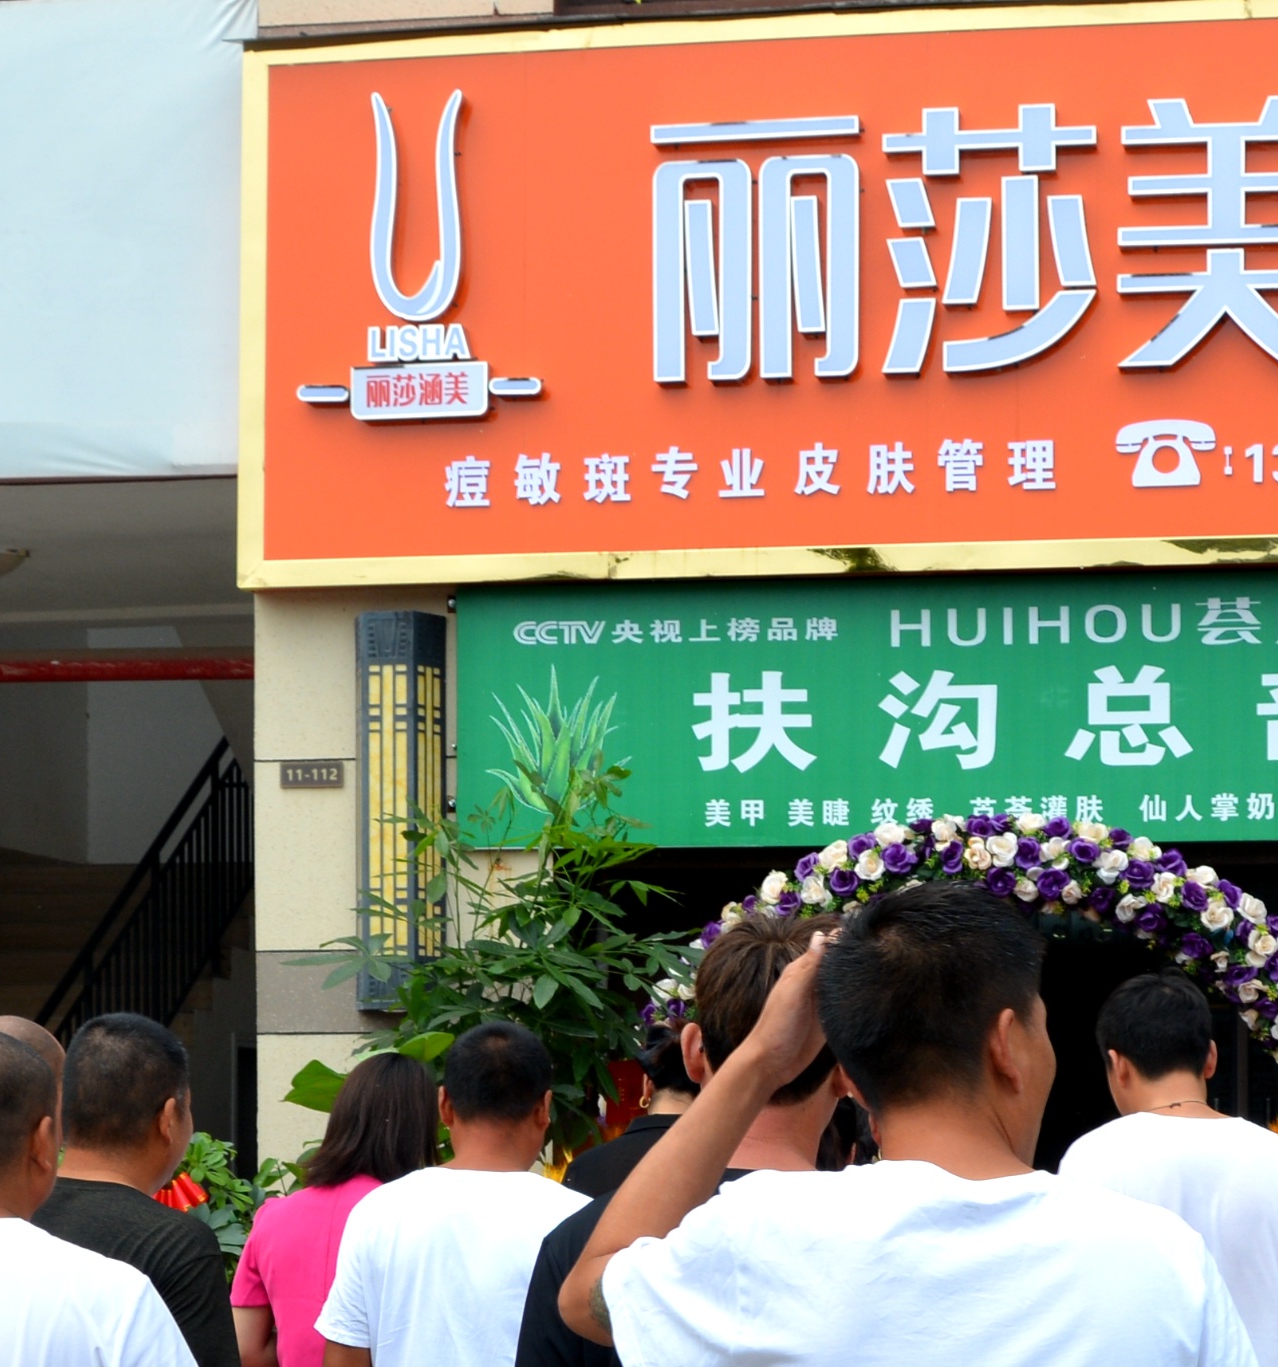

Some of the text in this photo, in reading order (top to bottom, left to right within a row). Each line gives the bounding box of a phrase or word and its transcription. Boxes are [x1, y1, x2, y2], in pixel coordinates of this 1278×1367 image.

[367, 323, 471, 362] LISHA
[365, 371, 471, 409] 丽莎涵美
[444, 438, 1057, 508] 痘敏斑专业皮肤管理
[286, 767, 338, 781] 11-112
[705, 798, 766, 828] 美甲
[787, 798, 851, 827] 美睫
